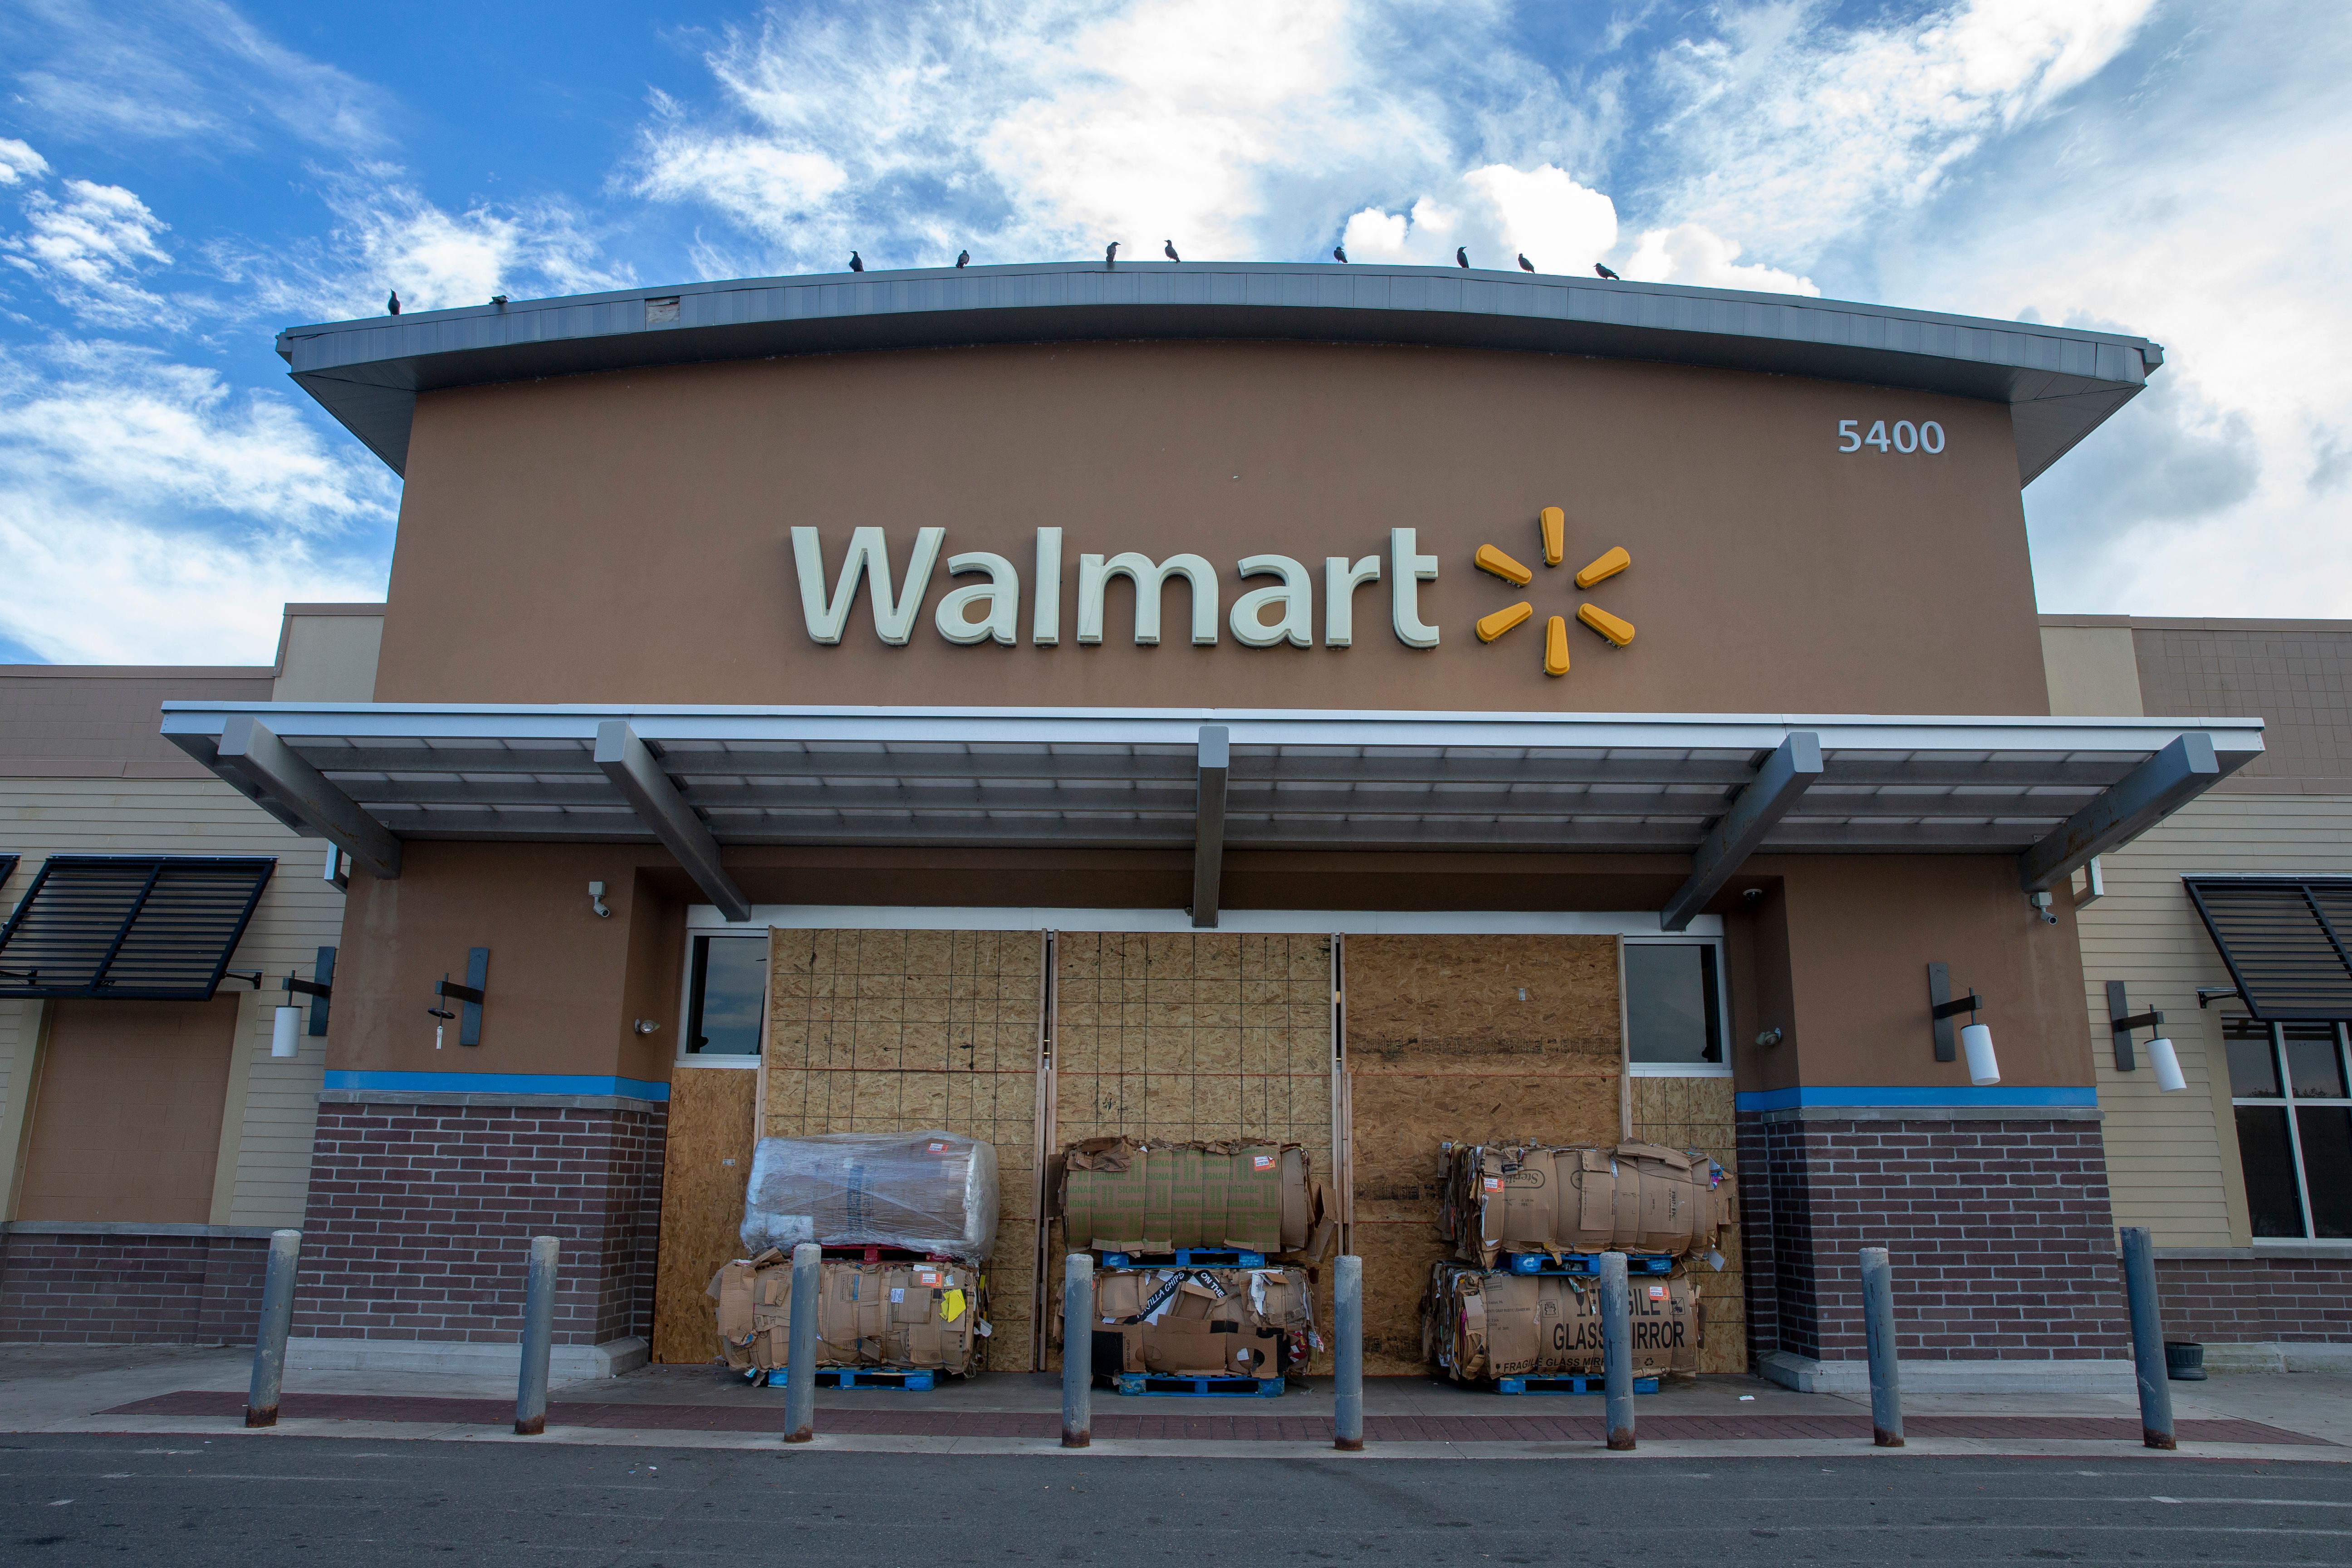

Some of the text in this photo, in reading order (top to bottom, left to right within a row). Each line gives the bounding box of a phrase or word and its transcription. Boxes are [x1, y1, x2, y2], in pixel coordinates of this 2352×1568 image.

[1838, 420, 1945, 454] 5400
[791, 526, 1440, 649] Walmart
[1092, 1172, 1126, 1181] SIGNAGE
[1117, 1186, 1152, 1194] SIGNAGE
[1172, 1186, 1205, 1194] SIGNAGE
[1225, 1186, 1259, 1194] SIGNAGE
[1117, 1200, 1152, 1208] SIGNAGE
[1172, 1199, 1205, 1207] SIGNAGE
[1226, 1199, 1259, 1207] SIGNAGE
[1165, 1271, 1184, 1292] CHIPS
[1200, 1272, 1225, 1298] ON THE
[1632, 1321, 1685, 1349] IRROR
[1503, 1357, 1543, 1373] FRAGILE
[1546, 1357, 1580, 1367] GLASS
